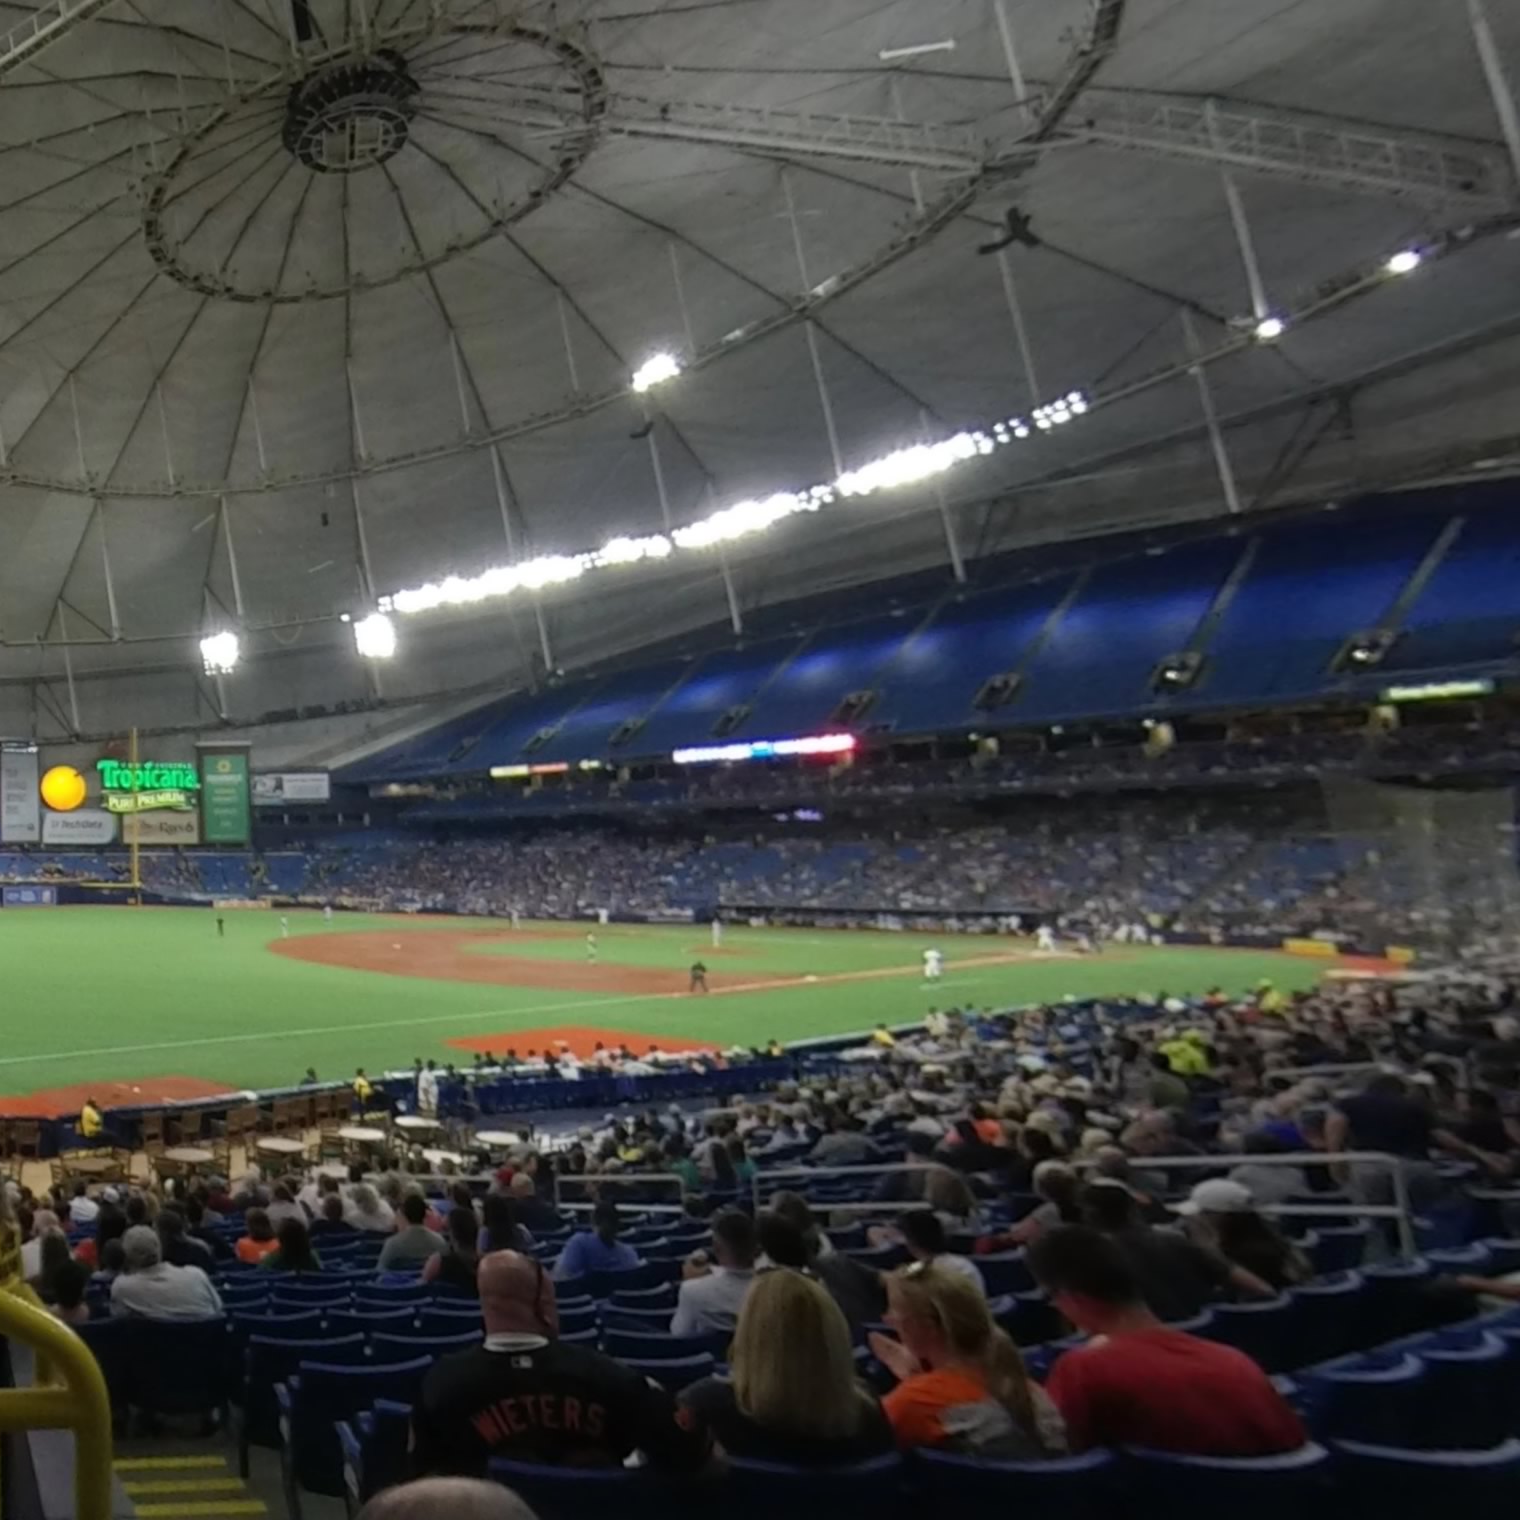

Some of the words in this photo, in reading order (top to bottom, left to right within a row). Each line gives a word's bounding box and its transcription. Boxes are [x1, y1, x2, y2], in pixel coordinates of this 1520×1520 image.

[97, 759, 198, 791] Tropicana
[137, 791, 186, 806] PREMIUM
[469, 1394, 607, 1446] WIETERS
